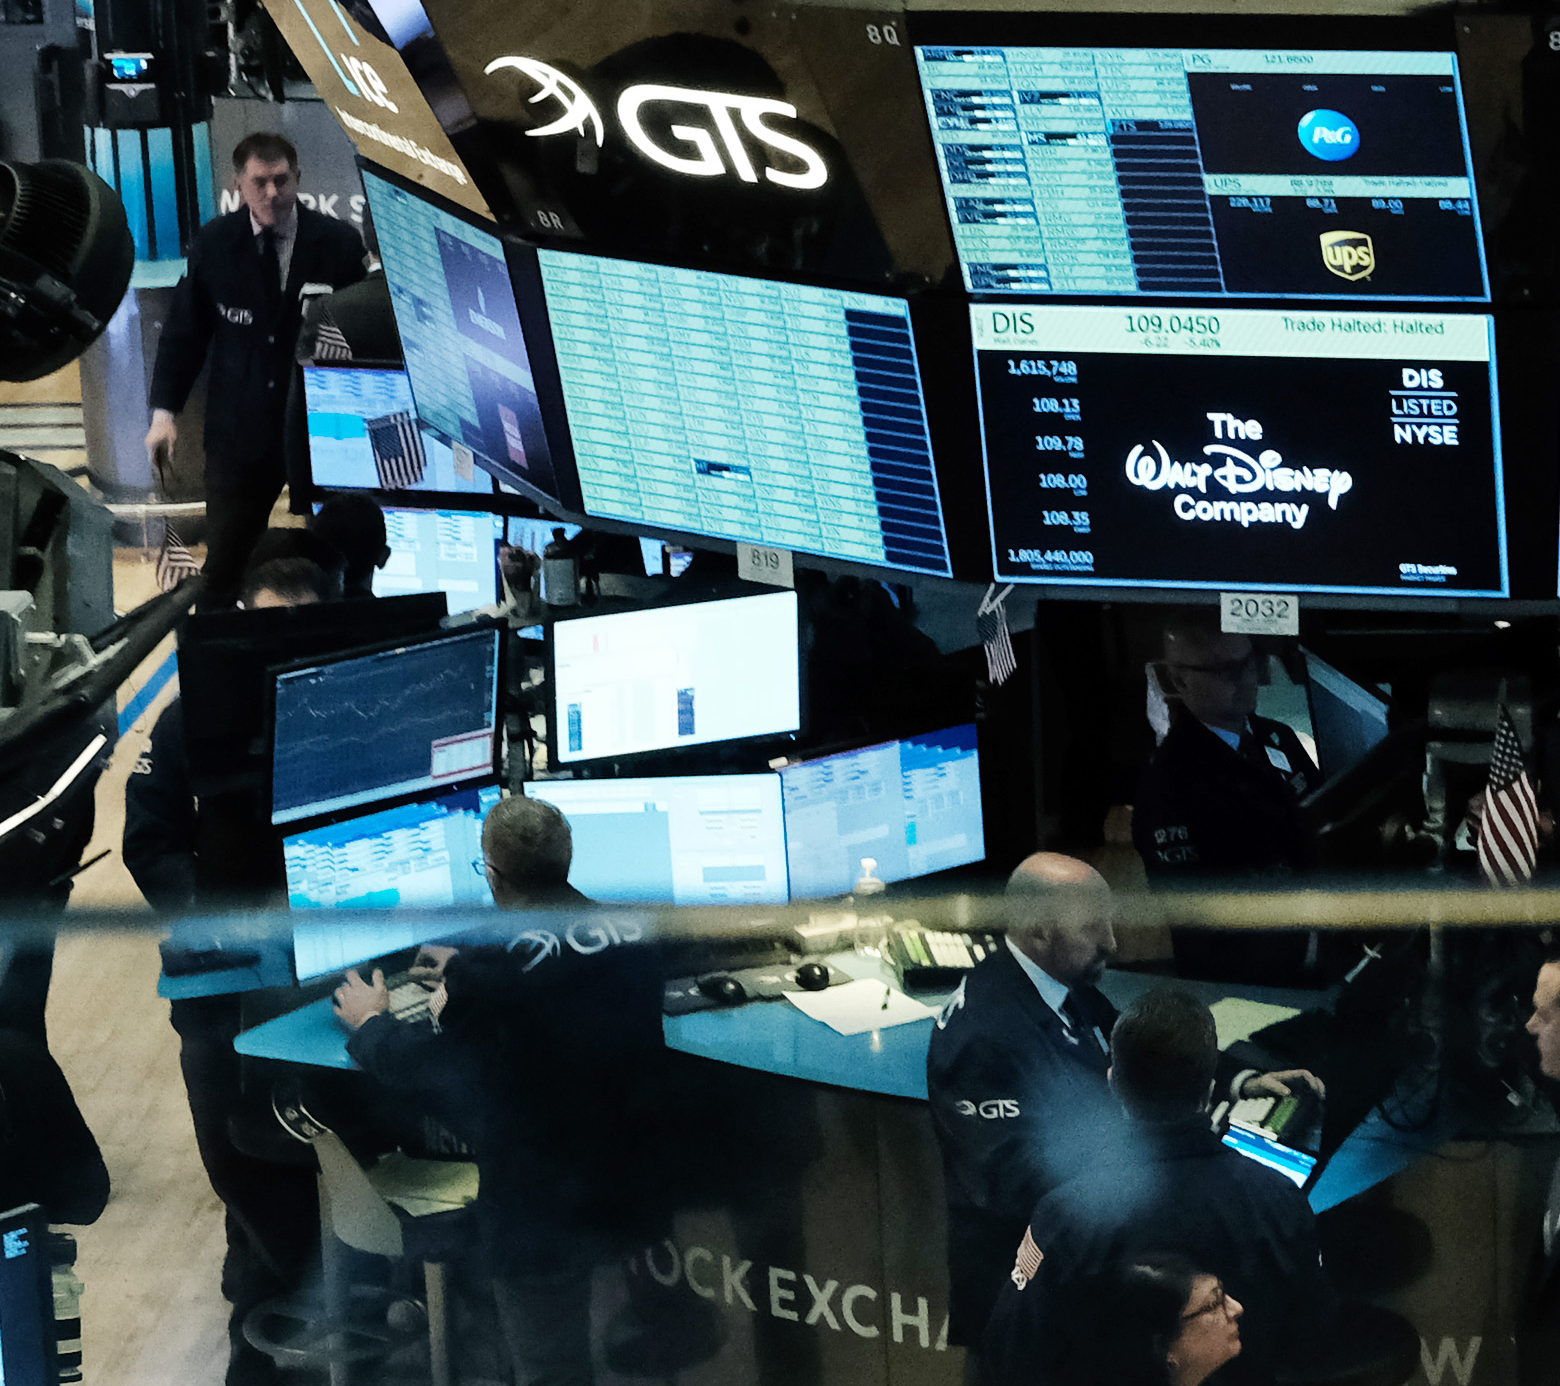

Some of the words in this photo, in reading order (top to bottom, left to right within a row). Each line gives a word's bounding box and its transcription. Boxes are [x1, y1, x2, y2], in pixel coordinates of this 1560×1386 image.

[617, 85, 829, 191] GTS
[1327, 244, 1370, 269] ups
[992, 312, 1036, 336] DIS
[1125, 314, 1221, 335] 109.0450
[1282, 317, 1324, 332] Trade
[1330, 318, 1389, 333] Halted:
[1392, 320, 1445, 335] Halted
[1403, 368, 1444, 389] DIS
[1390, 398, 1457, 417] LISTED
[1206, 412, 1263, 441] The
[1393, 423, 1459, 446] NYSE
[1173, 494, 1309, 528] Company
[751, 549, 781, 568] 819
[1229, 597, 1291, 619] 2032
[980, 1098, 1020, 1121] GTS
[644, 1237, 757, 1313] OCK
